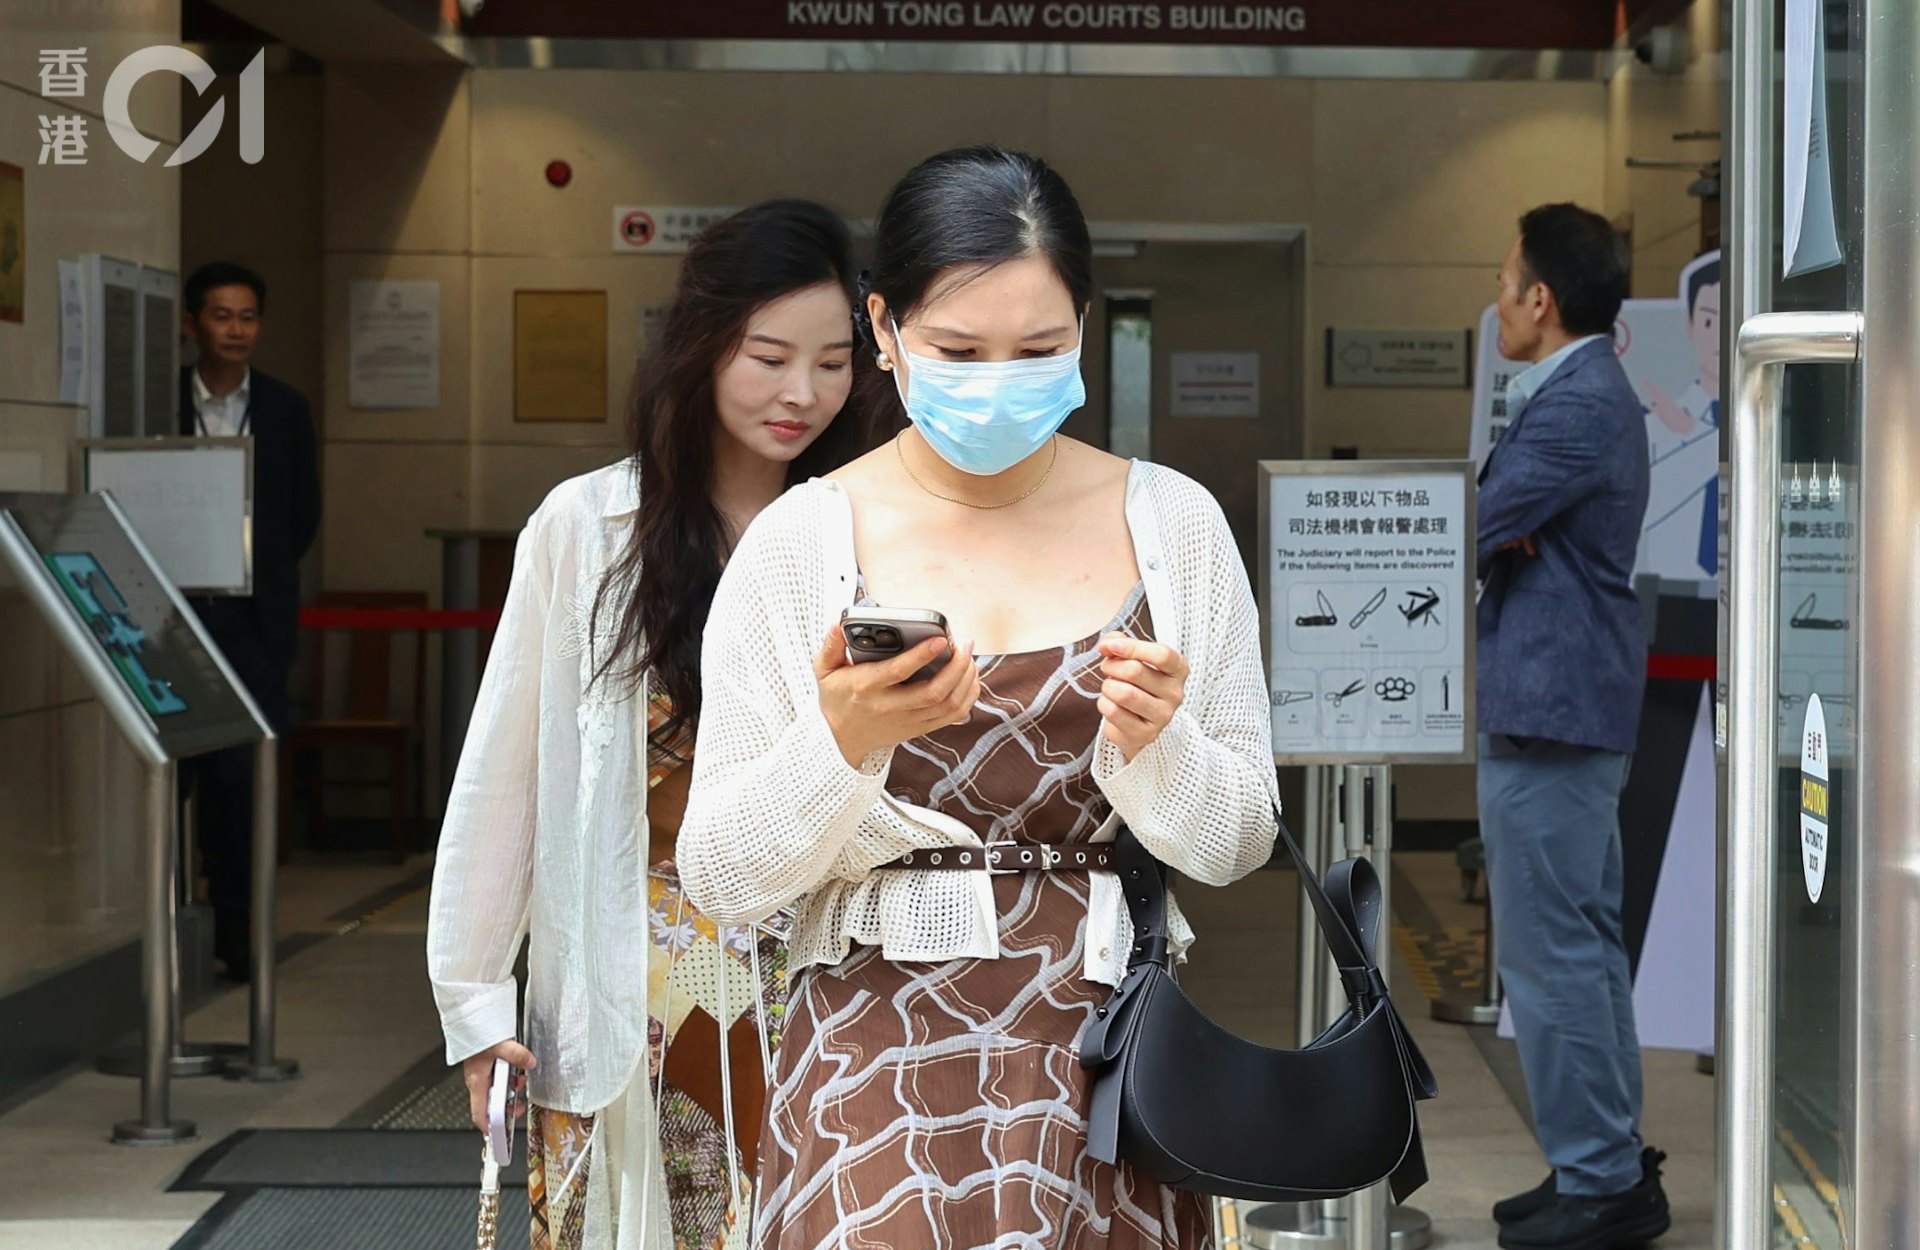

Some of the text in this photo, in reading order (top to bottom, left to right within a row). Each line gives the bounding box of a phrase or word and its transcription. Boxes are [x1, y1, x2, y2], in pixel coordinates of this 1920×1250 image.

[788, 2, 1306, 30] KWUN TONG LAW COURTS BUILDING
[1306, 490, 1430, 508] 如發現以下物品
[1289, 517, 1449, 535] 司法機構會報警處理
[1277, 548, 1456, 559] The Judiciary will report to the Police
[1279, 561, 1454, 572] if the following items are discovered
[1803, 779, 1827, 817] CAUTION
